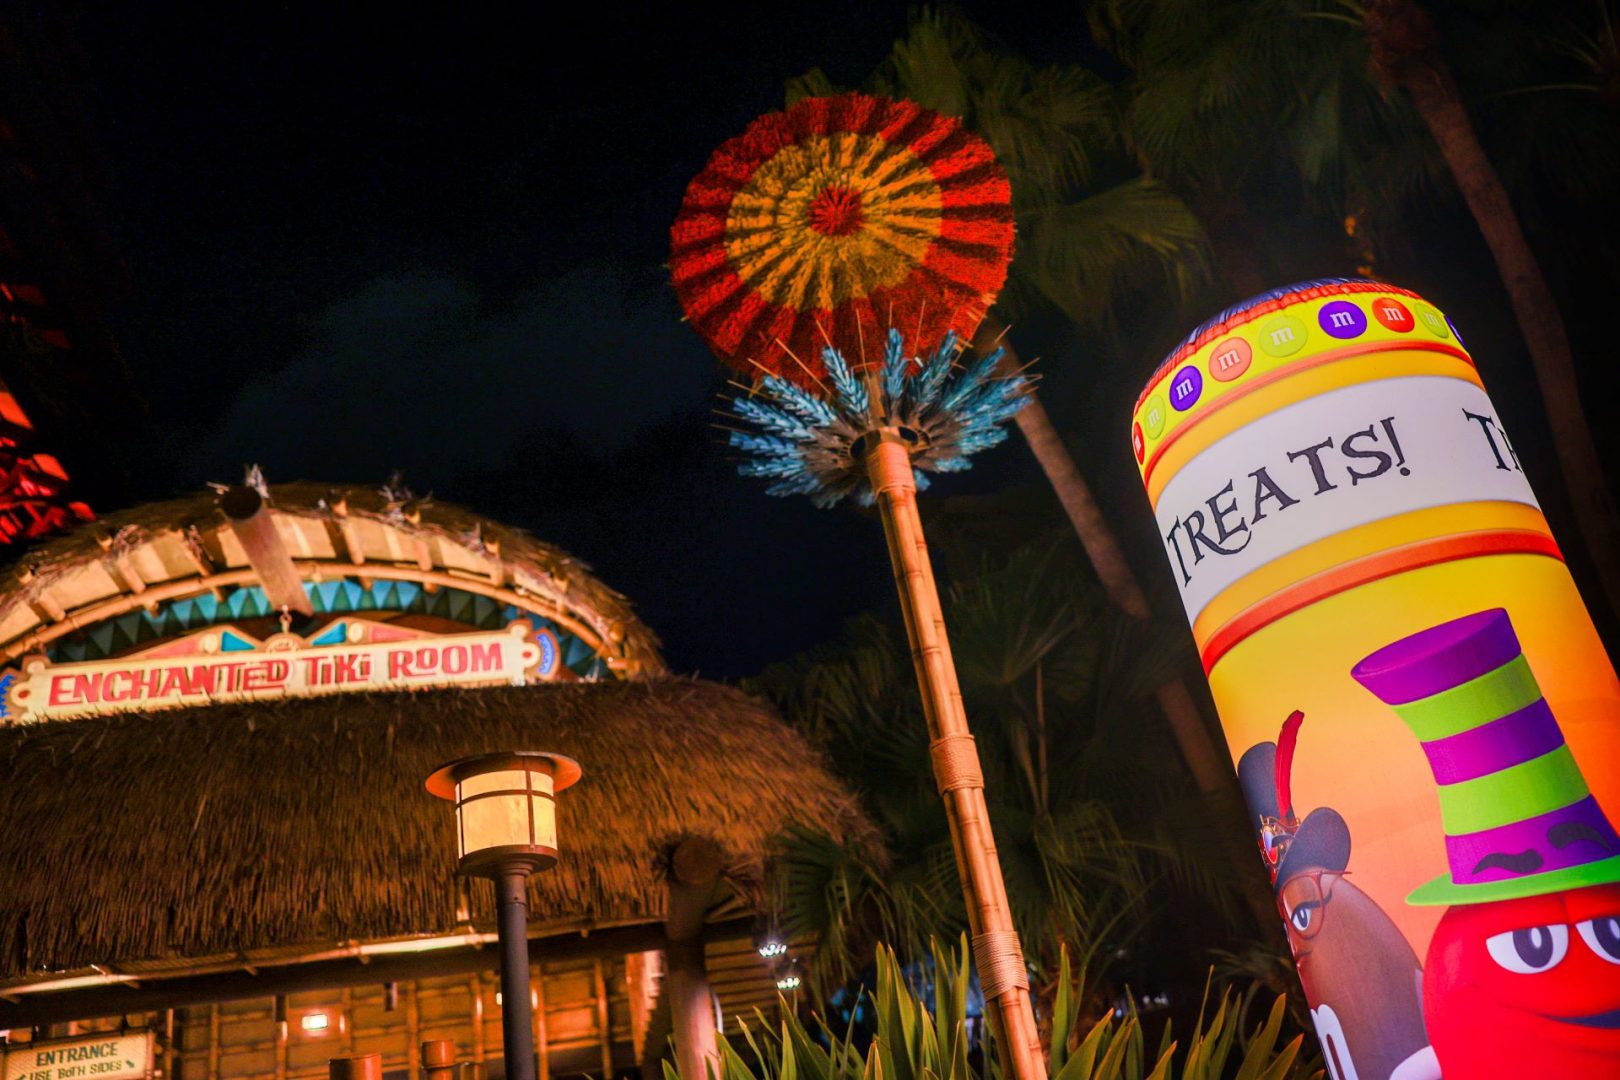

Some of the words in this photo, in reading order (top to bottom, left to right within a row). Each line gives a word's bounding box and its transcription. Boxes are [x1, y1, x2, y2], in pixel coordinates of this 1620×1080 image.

[1329, 311, 1355, 328] m
[1382, 307, 1405, 321] m
[1424, 312, 1441, 327] m
[1270, 327, 1295, 346] m
[1218, 349, 1241, 372] m
[1175, 378, 1194, 401] m
[1147, 407, 1160, 428] m
[1166, 416, 1411, 588] TREATS!
[36, 1042, 118, 1067] ENTRANCE
[29, 1070, 52, 1080] USE
[90, 1060, 122, 1074] SIDES
